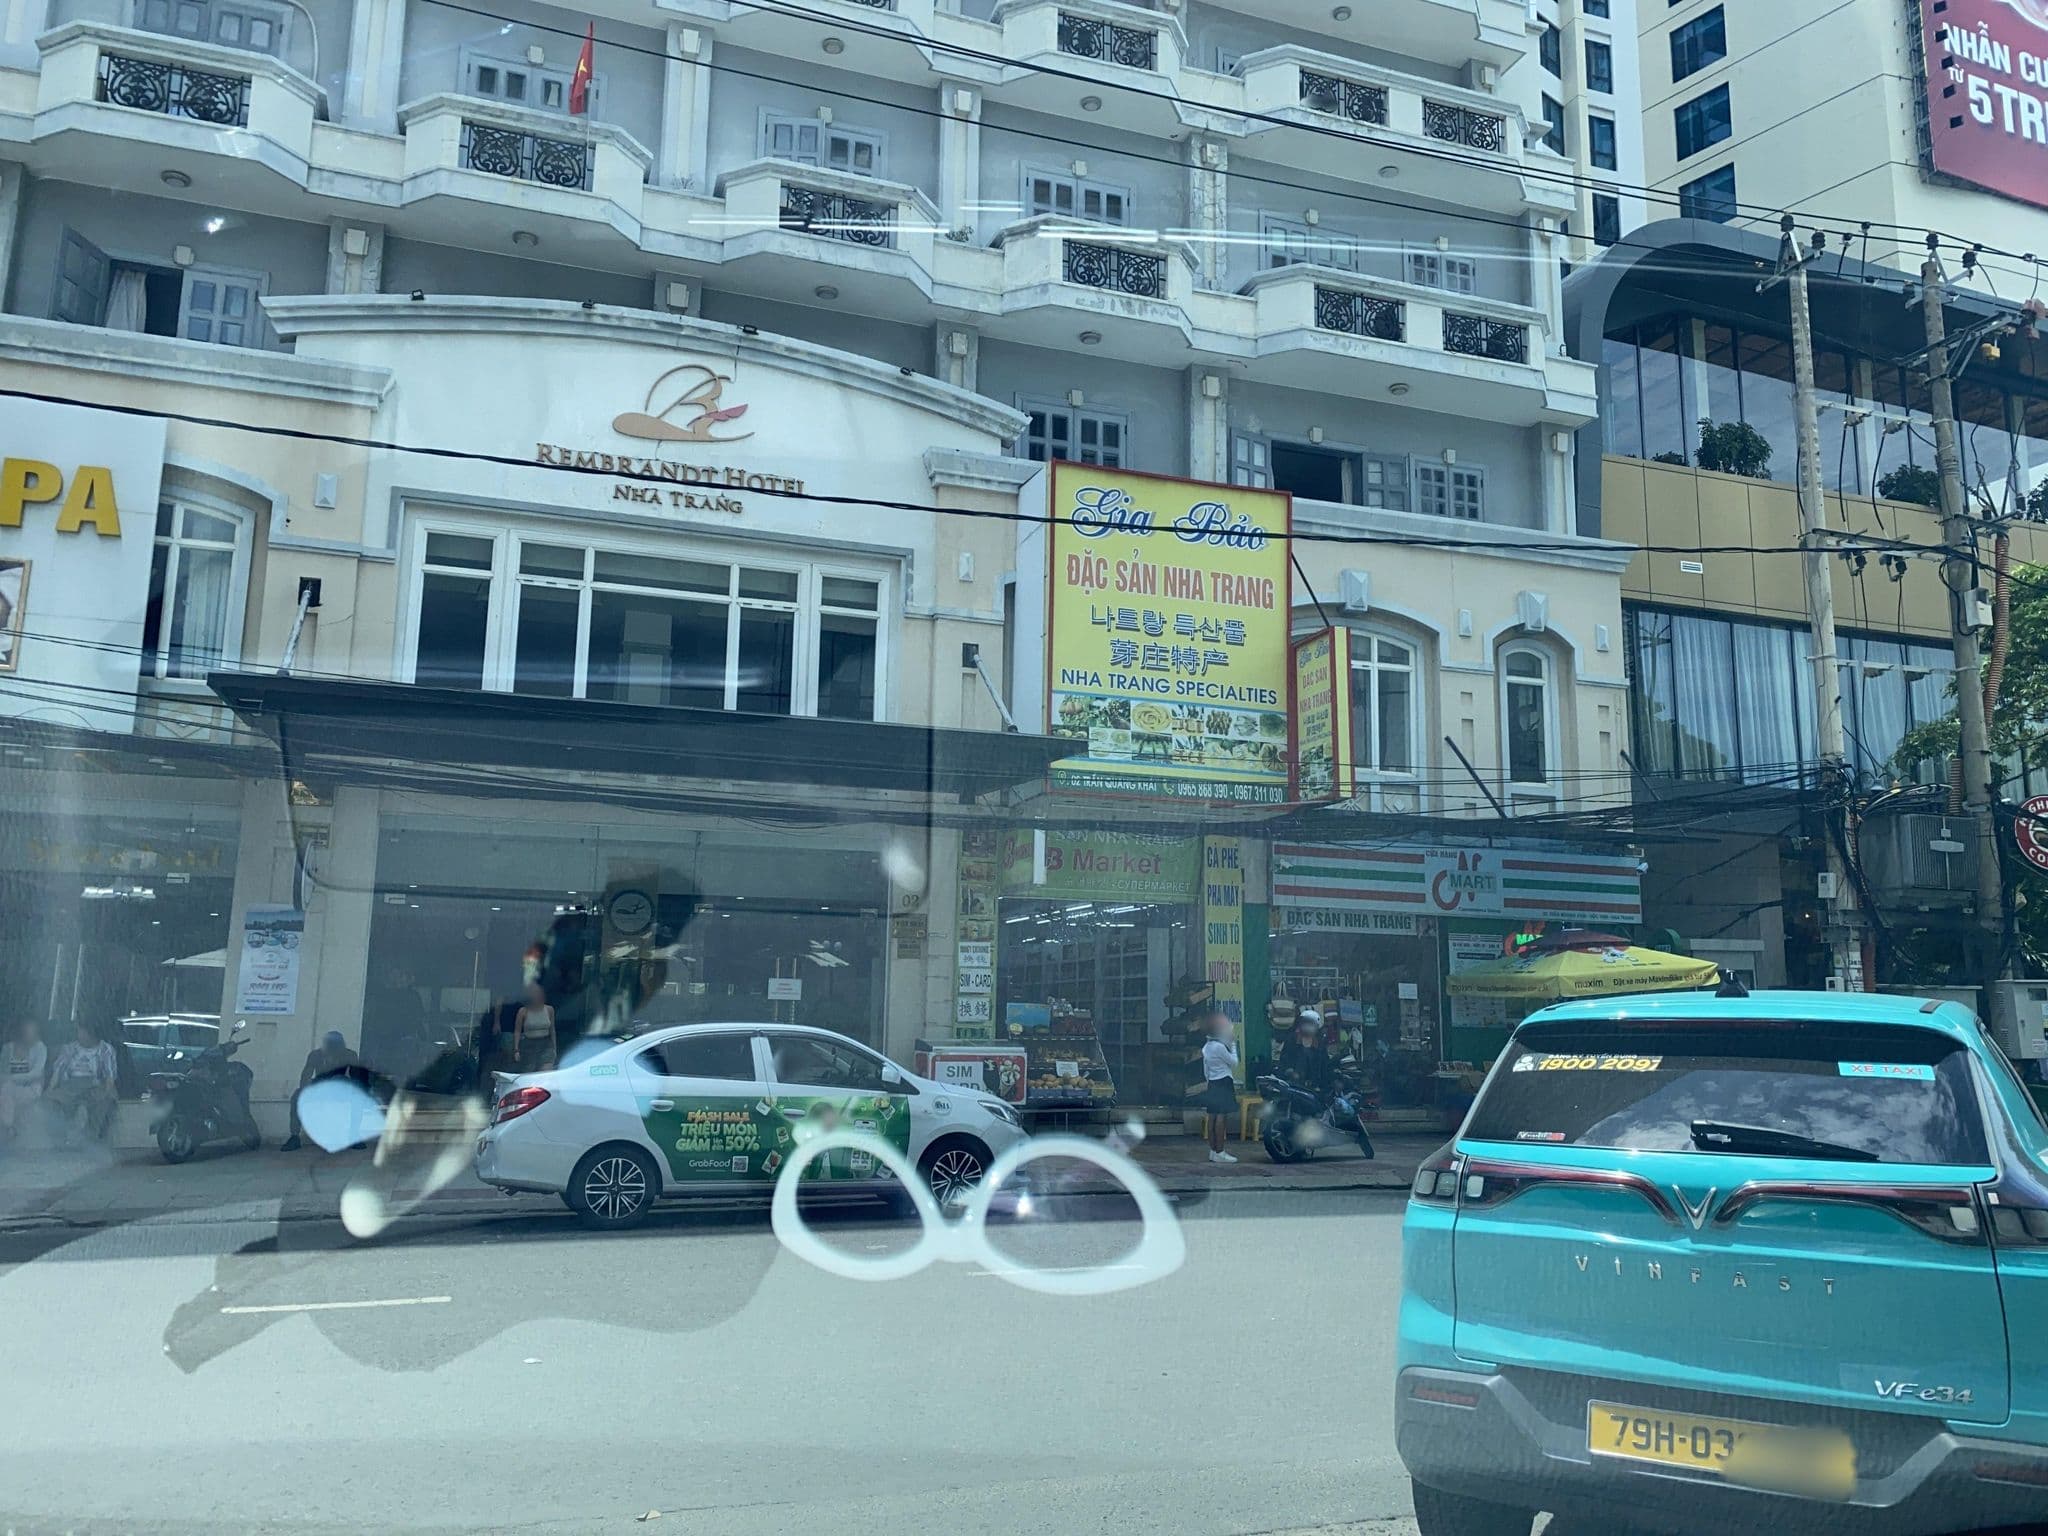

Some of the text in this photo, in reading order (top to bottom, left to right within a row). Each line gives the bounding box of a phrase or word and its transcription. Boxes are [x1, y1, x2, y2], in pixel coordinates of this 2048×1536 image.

[613, 484, 743, 514] NHA TRANG
[1072, 487, 1267, 550] Gia Bảo
[1067, 548, 1275, 610] ĐẶC SẢN NHA TRANG
[1091, 605, 1168, 634] 나트랑
[1061, 668, 1278, 705] NHA TRANG SPECIALTIES
[1214, 784, 1228, 799] 390
[1234, 784, 1252, 800] 0967
[1254, 786, 1268, 802] 311
[1269, 787, 1283, 803] 030
[1072, 849, 1161, 875] Market
[1449, 872, 1494, 889] MART
[1345, 912, 1370, 928] NHA
[1373, 914, 1412, 930] TRANG
[946, 1065, 972, 1078] SIM
[1539, 1058, 1597, 1071] 1900
[1852, 1065, 1923, 1076] XE TAXI
[689, 1159, 731, 1168] GrabFood
[1574, 1255, 1836, 1296] VINFAST
